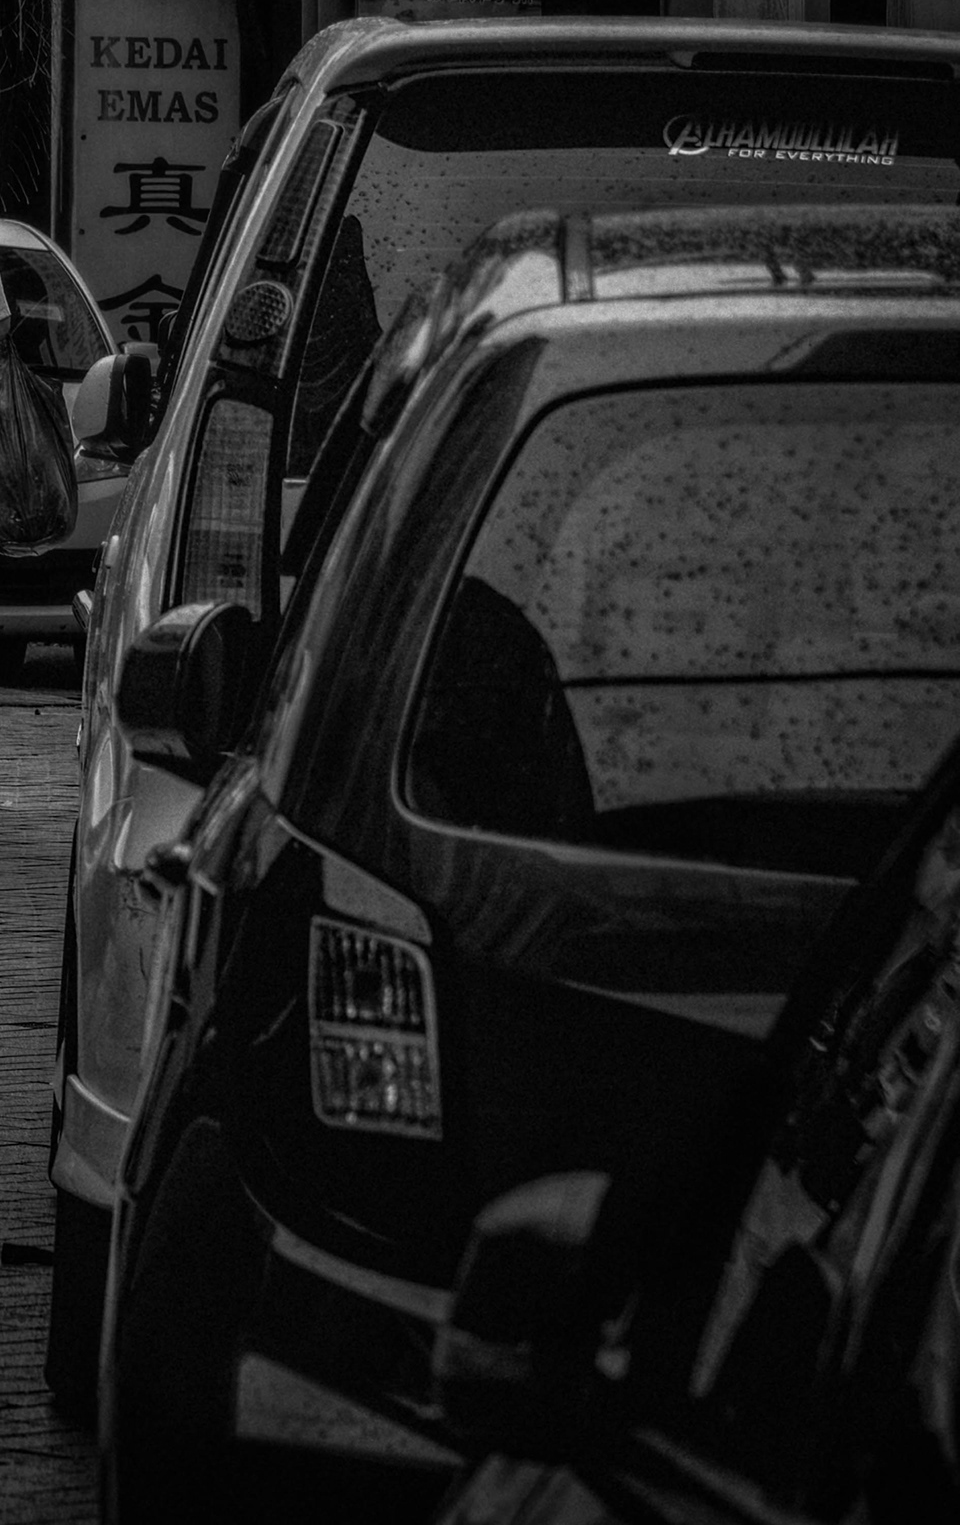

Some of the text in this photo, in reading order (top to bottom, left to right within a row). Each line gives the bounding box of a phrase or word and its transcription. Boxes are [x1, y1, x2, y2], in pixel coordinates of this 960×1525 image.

[89, 35, 229, 71] KEDAI
[97, 90, 220, 124] EMAS
[726, 147, 896, 167] FOR EVERYTHING
